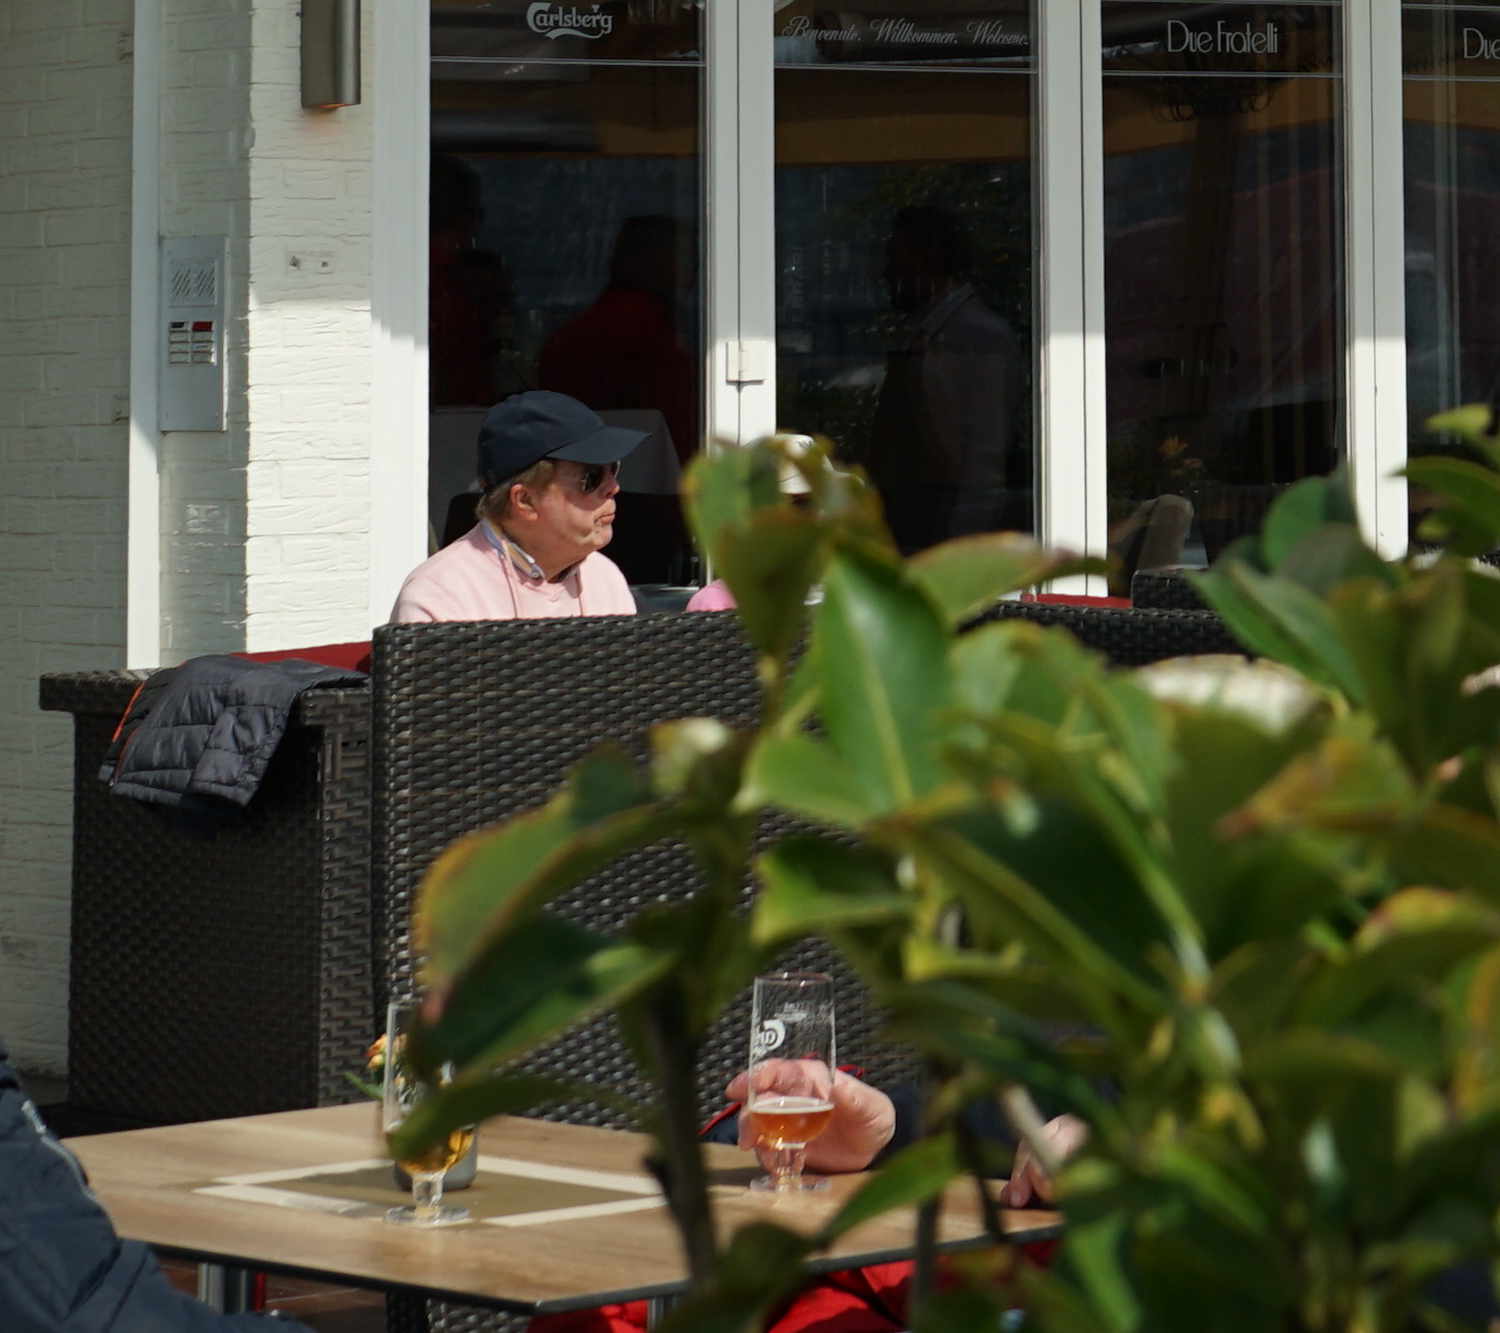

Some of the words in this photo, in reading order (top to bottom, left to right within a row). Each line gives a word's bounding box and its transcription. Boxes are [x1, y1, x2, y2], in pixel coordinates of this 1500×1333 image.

[526, 1, 614, 38] Carlsberg
[1167, 19, 1213, 54] Due
[1216, 20, 1279, 54] Fratelli
